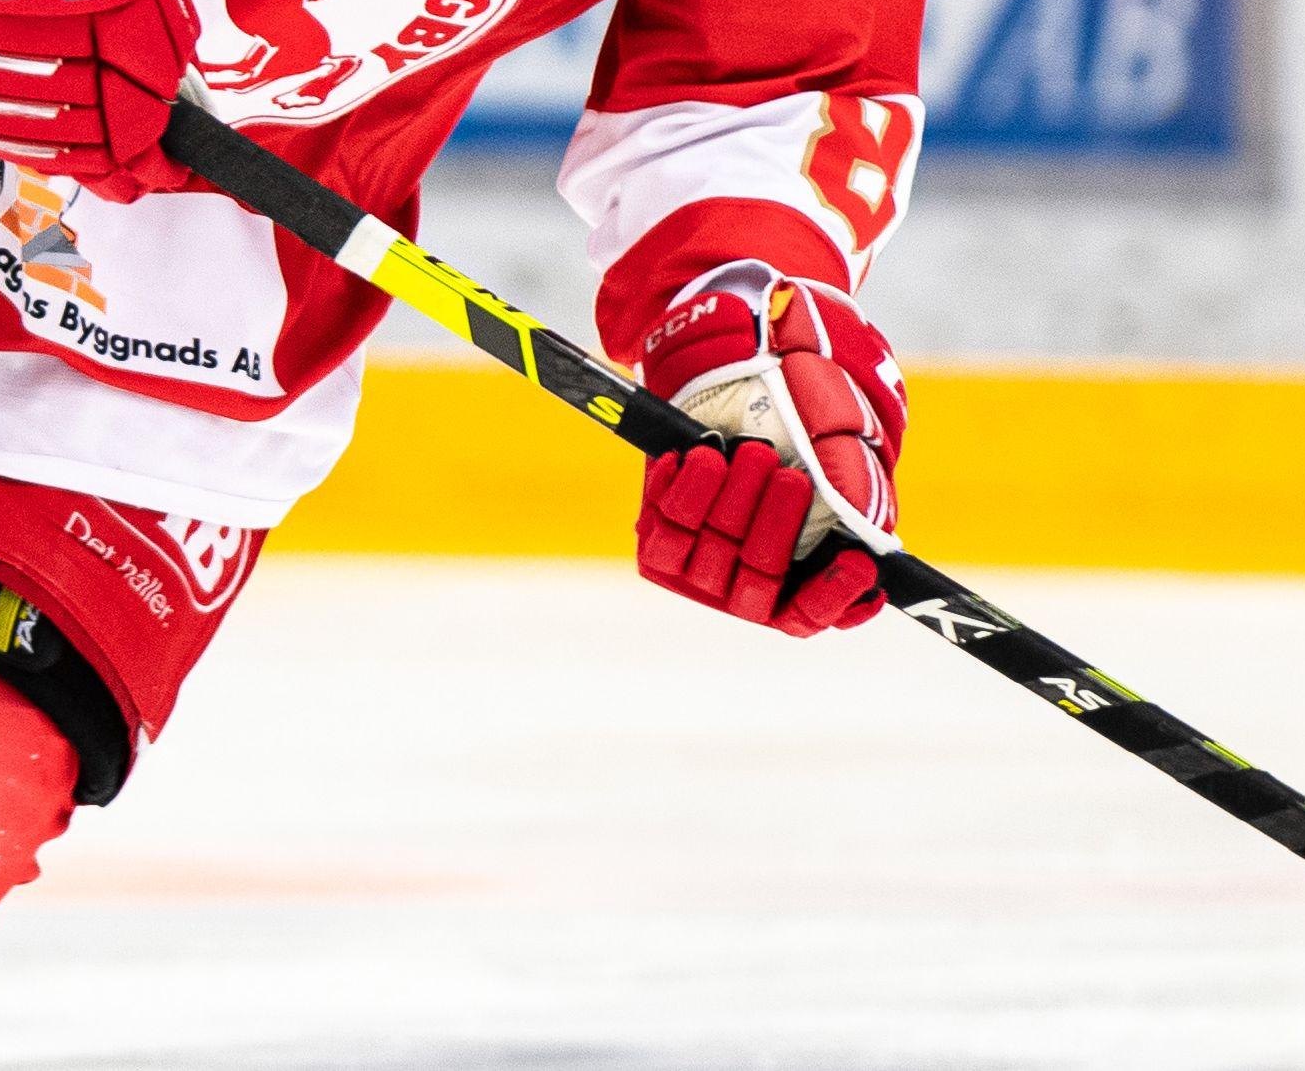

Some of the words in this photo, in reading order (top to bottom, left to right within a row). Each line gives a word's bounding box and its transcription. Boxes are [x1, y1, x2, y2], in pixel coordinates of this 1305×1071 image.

[800, 90, 915, 296] 8
[59, 301, 218, 368] Byggnads
[231, 347, 261, 381] AB
